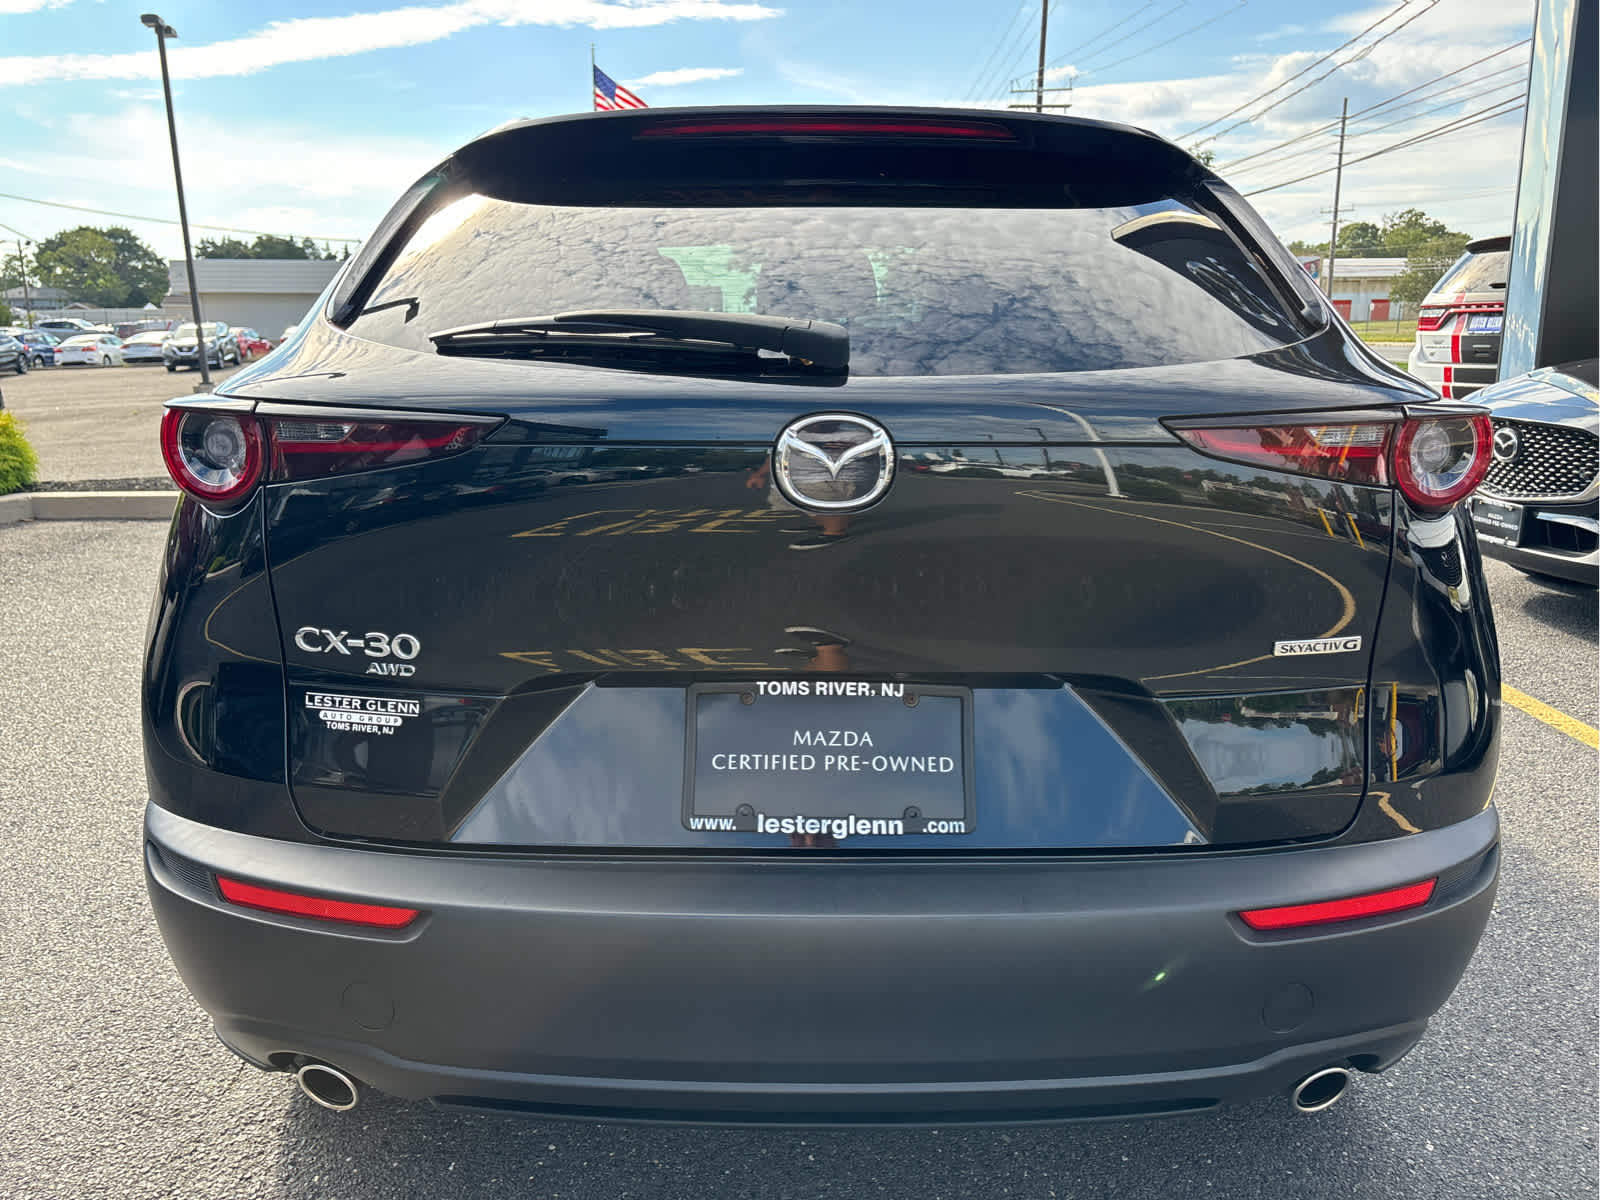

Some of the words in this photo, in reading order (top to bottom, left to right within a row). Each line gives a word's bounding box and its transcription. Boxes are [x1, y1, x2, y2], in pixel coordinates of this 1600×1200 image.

[295, 627, 421, 660] CX-30
[366, 662, 416, 677] AWD
[756, 681, 810, 696] TOMS
[815, 681, 876, 697] RIVER,
[881, 682, 905, 697] NJ
[305, 694, 361, 709] LESTER
[366, 700, 420, 714] GLENN
[322, 712, 352, 721] AUTO
[359, 714, 399, 724] GROUP
[326, 721, 351, 731] TOMS
[352, 723, 382, 735] RIVER,
[382, 726, 394, 735] NJ
[793, 730, 874, 747] MAZDA
[711, 753, 816, 771] CERTIFIED
[824, 754, 954, 773] PRE-OWNED
[690, 817, 737, 831] www.
[757, 814, 904, 840] lesterglenn
[922, 820, 965, 833] .com
